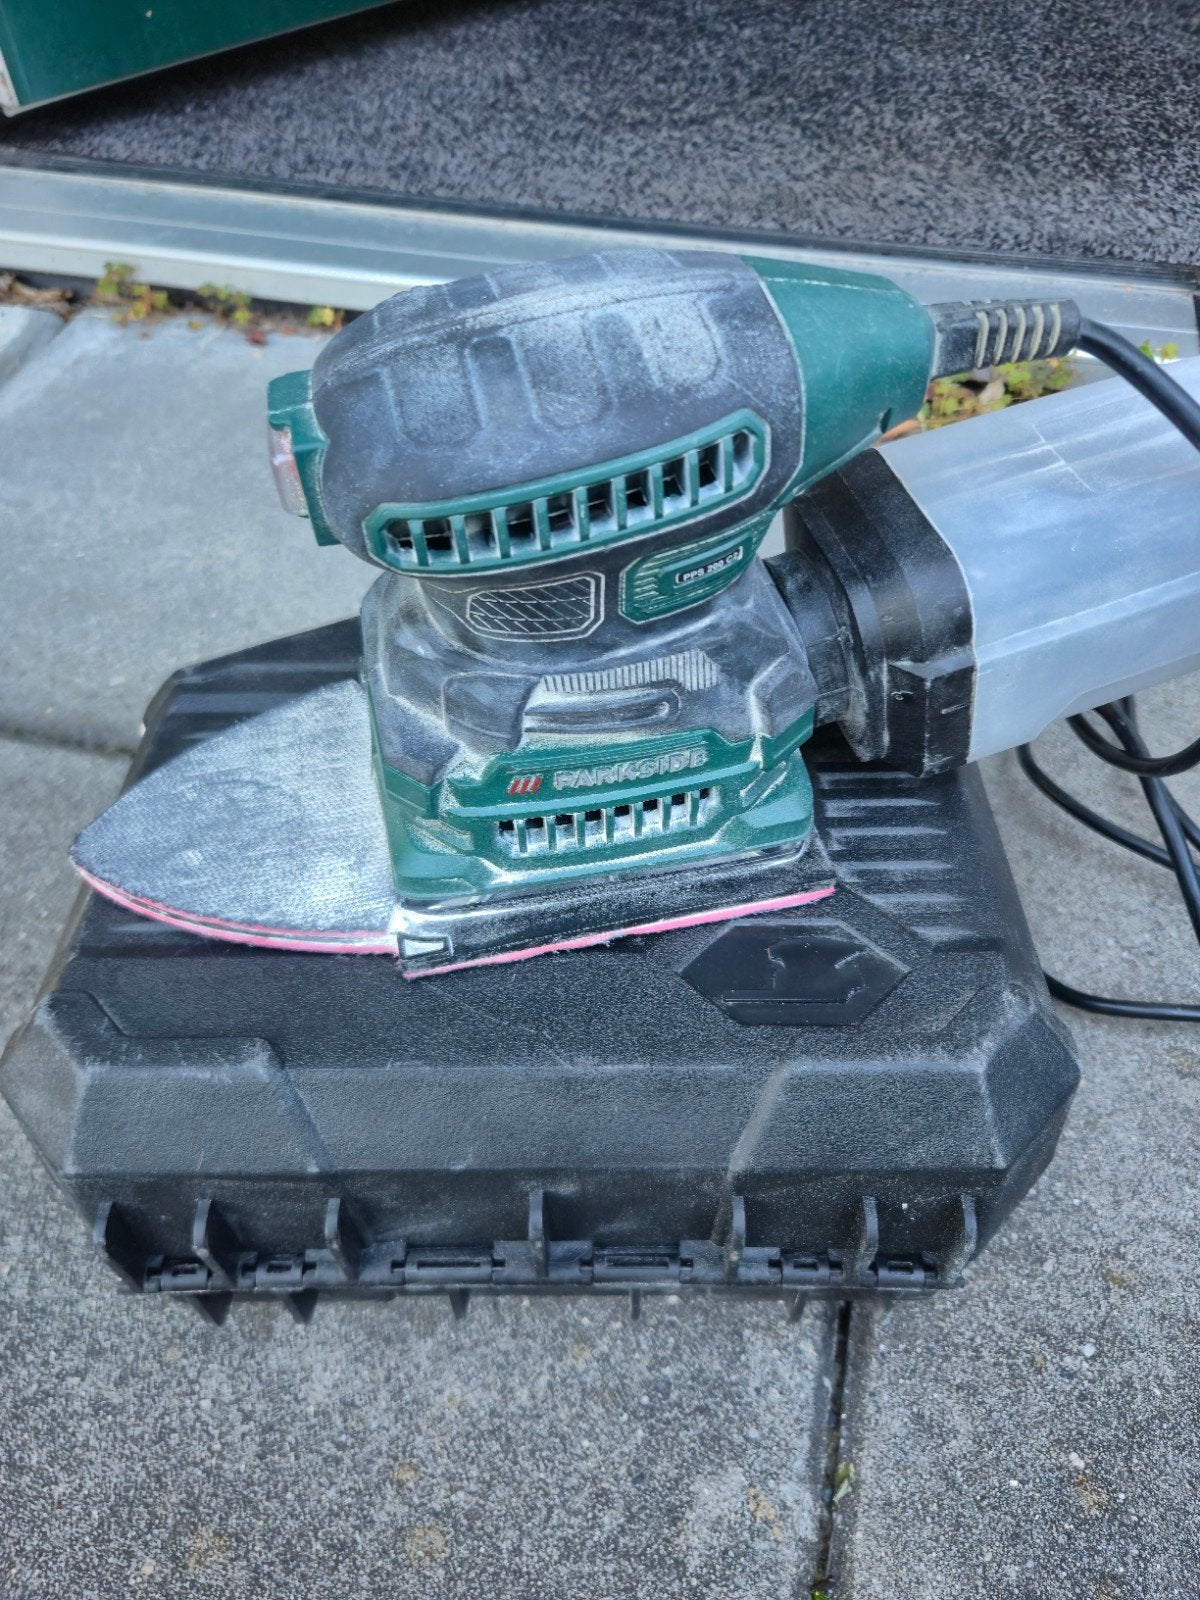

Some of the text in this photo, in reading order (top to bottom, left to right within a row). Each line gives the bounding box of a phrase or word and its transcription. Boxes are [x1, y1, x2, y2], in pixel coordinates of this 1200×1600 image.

[683, 567, 705, 581] PPS
[707, 560, 724, 573] 200
[553, 749, 709, 790] PARKSIDE
